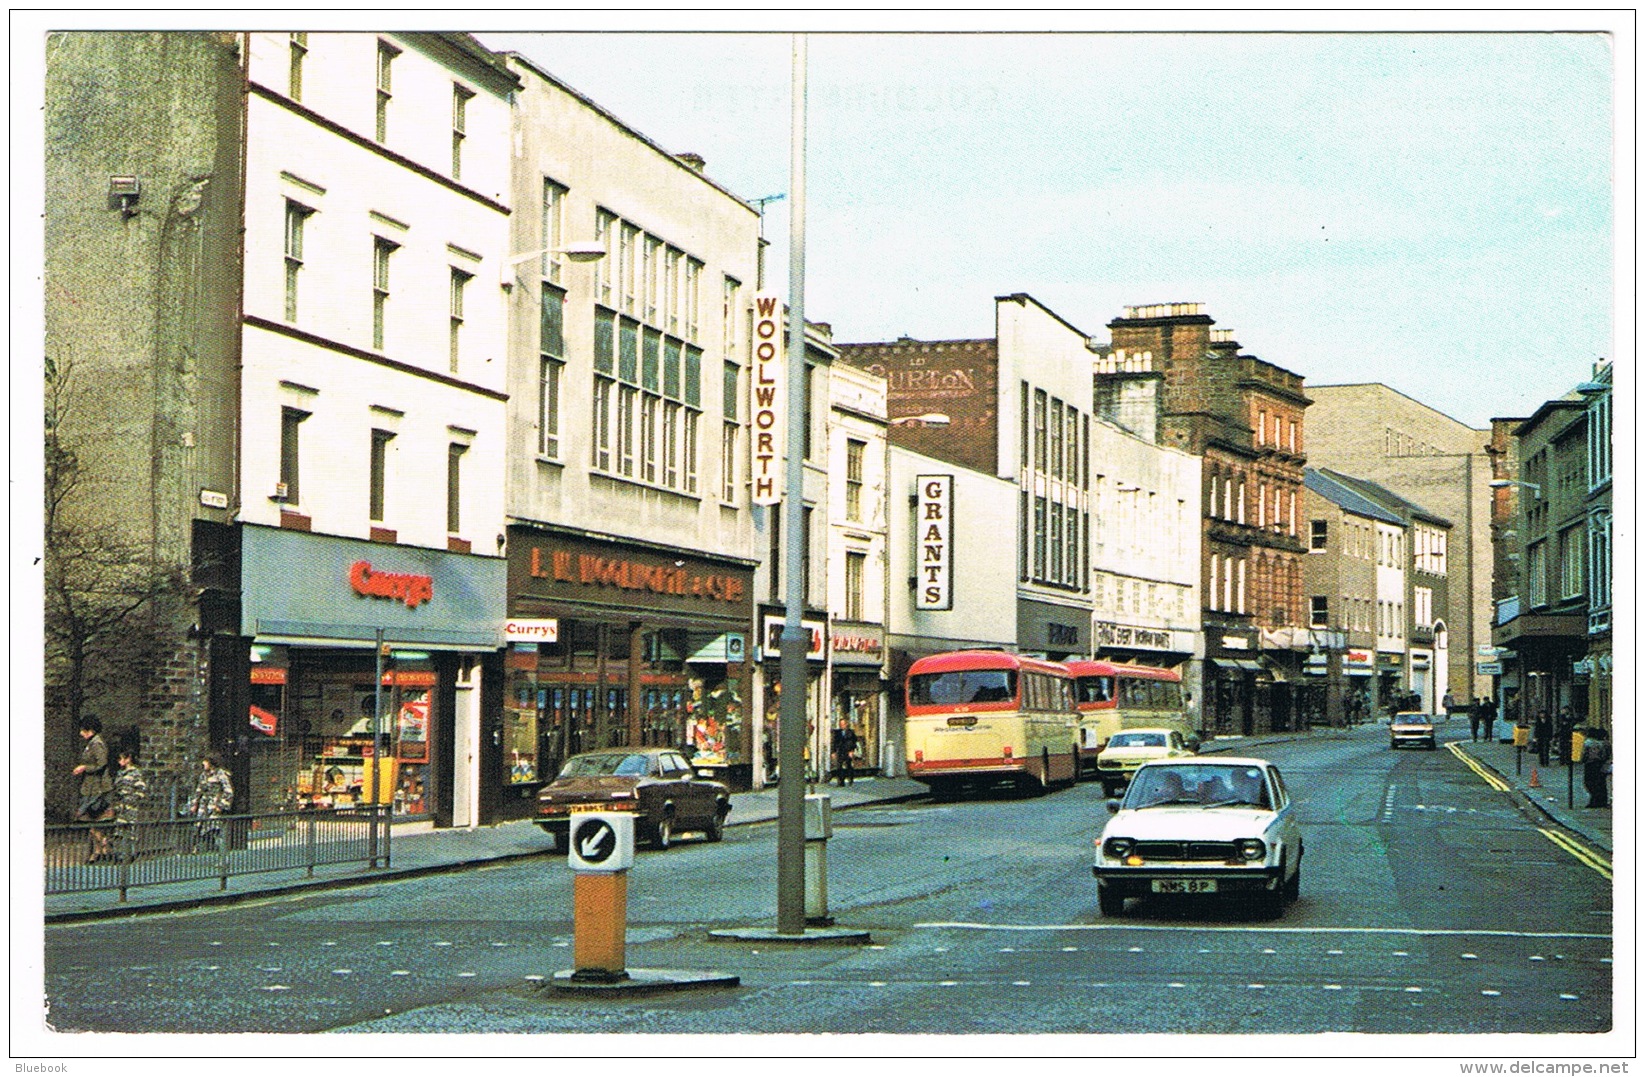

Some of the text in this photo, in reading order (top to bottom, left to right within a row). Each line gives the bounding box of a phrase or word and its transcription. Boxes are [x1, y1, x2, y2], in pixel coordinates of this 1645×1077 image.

[756, 298, 777, 497] WOOLWORTH
[925, 482, 942, 603] GRANTS
[506, 623, 556, 637] Currys
